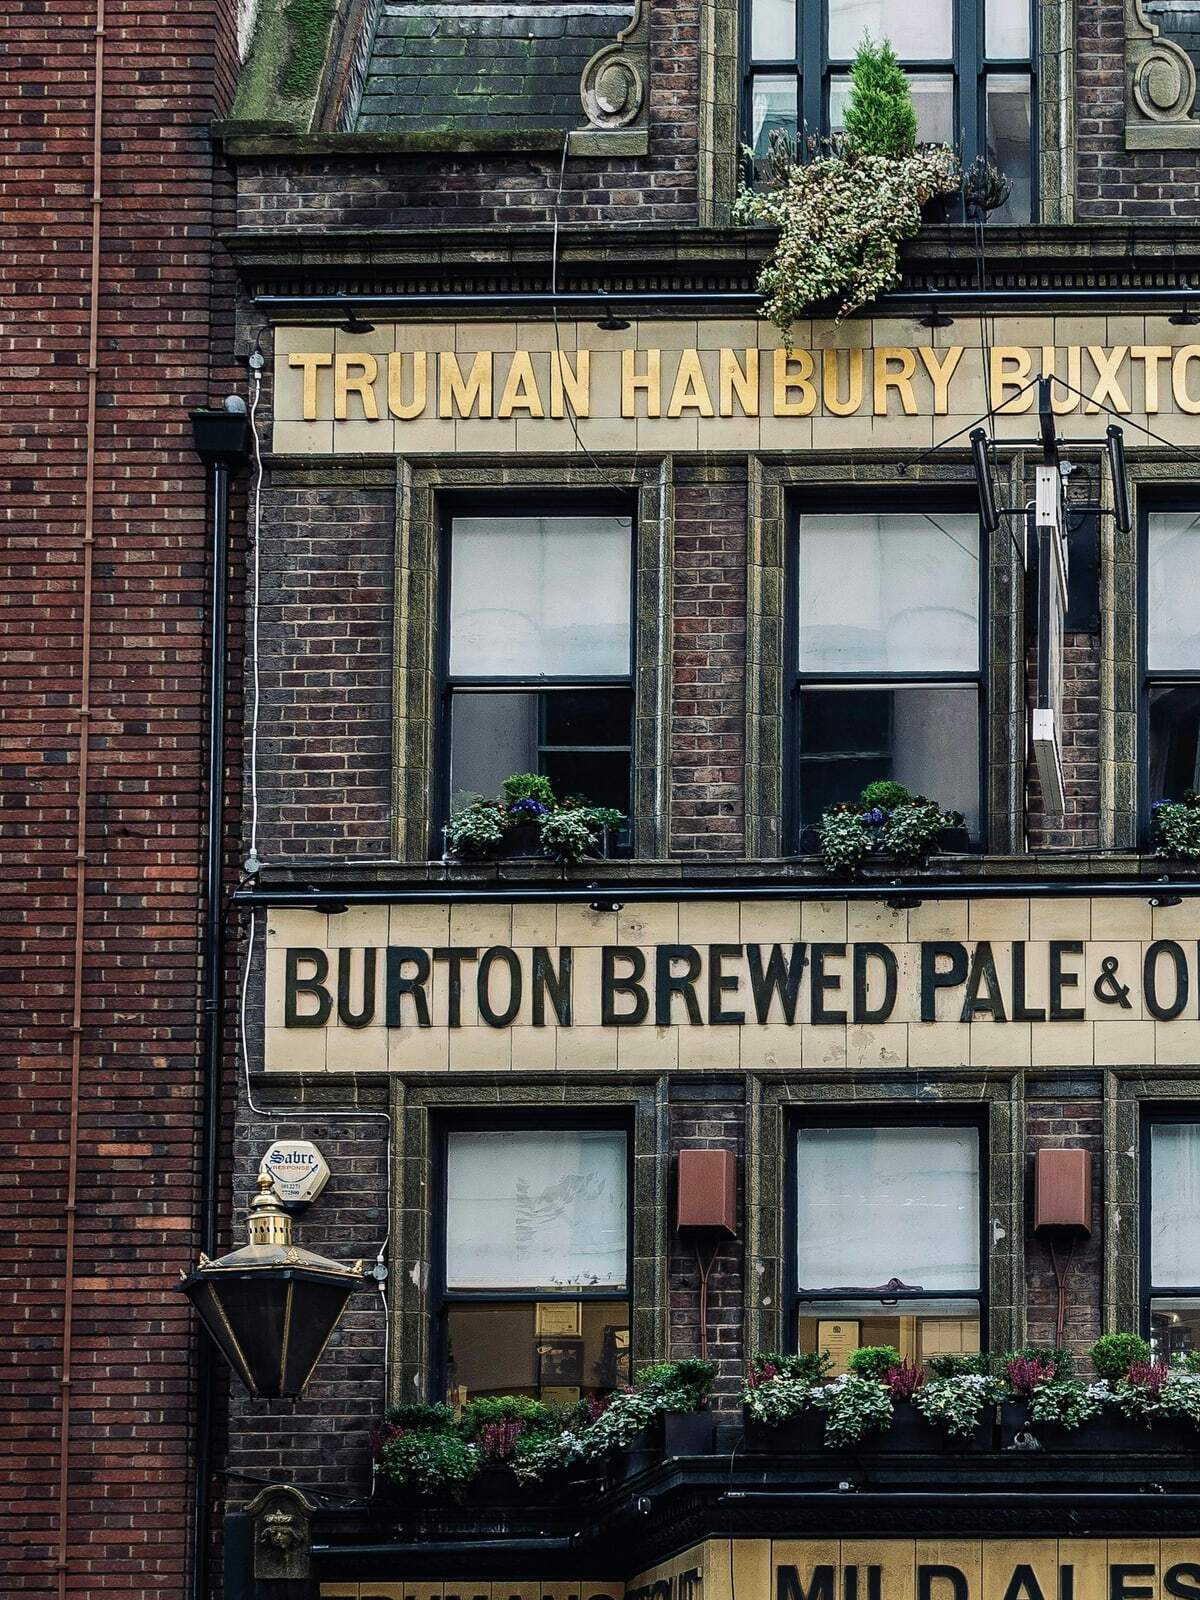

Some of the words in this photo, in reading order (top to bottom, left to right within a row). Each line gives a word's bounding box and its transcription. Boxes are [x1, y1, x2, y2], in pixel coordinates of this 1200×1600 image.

[288, 350, 590, 421] TRUMAN
[620, 344, 964, 419] HANBURY
[283, 946, 572, 1029] BURTON
[601, 942, 898, 1026] BREWED
[920, 939, 1086, 1022] PALE
[1093, 955, 1132, 1009] &
[269, 1150, 315, 1164] Sabre
